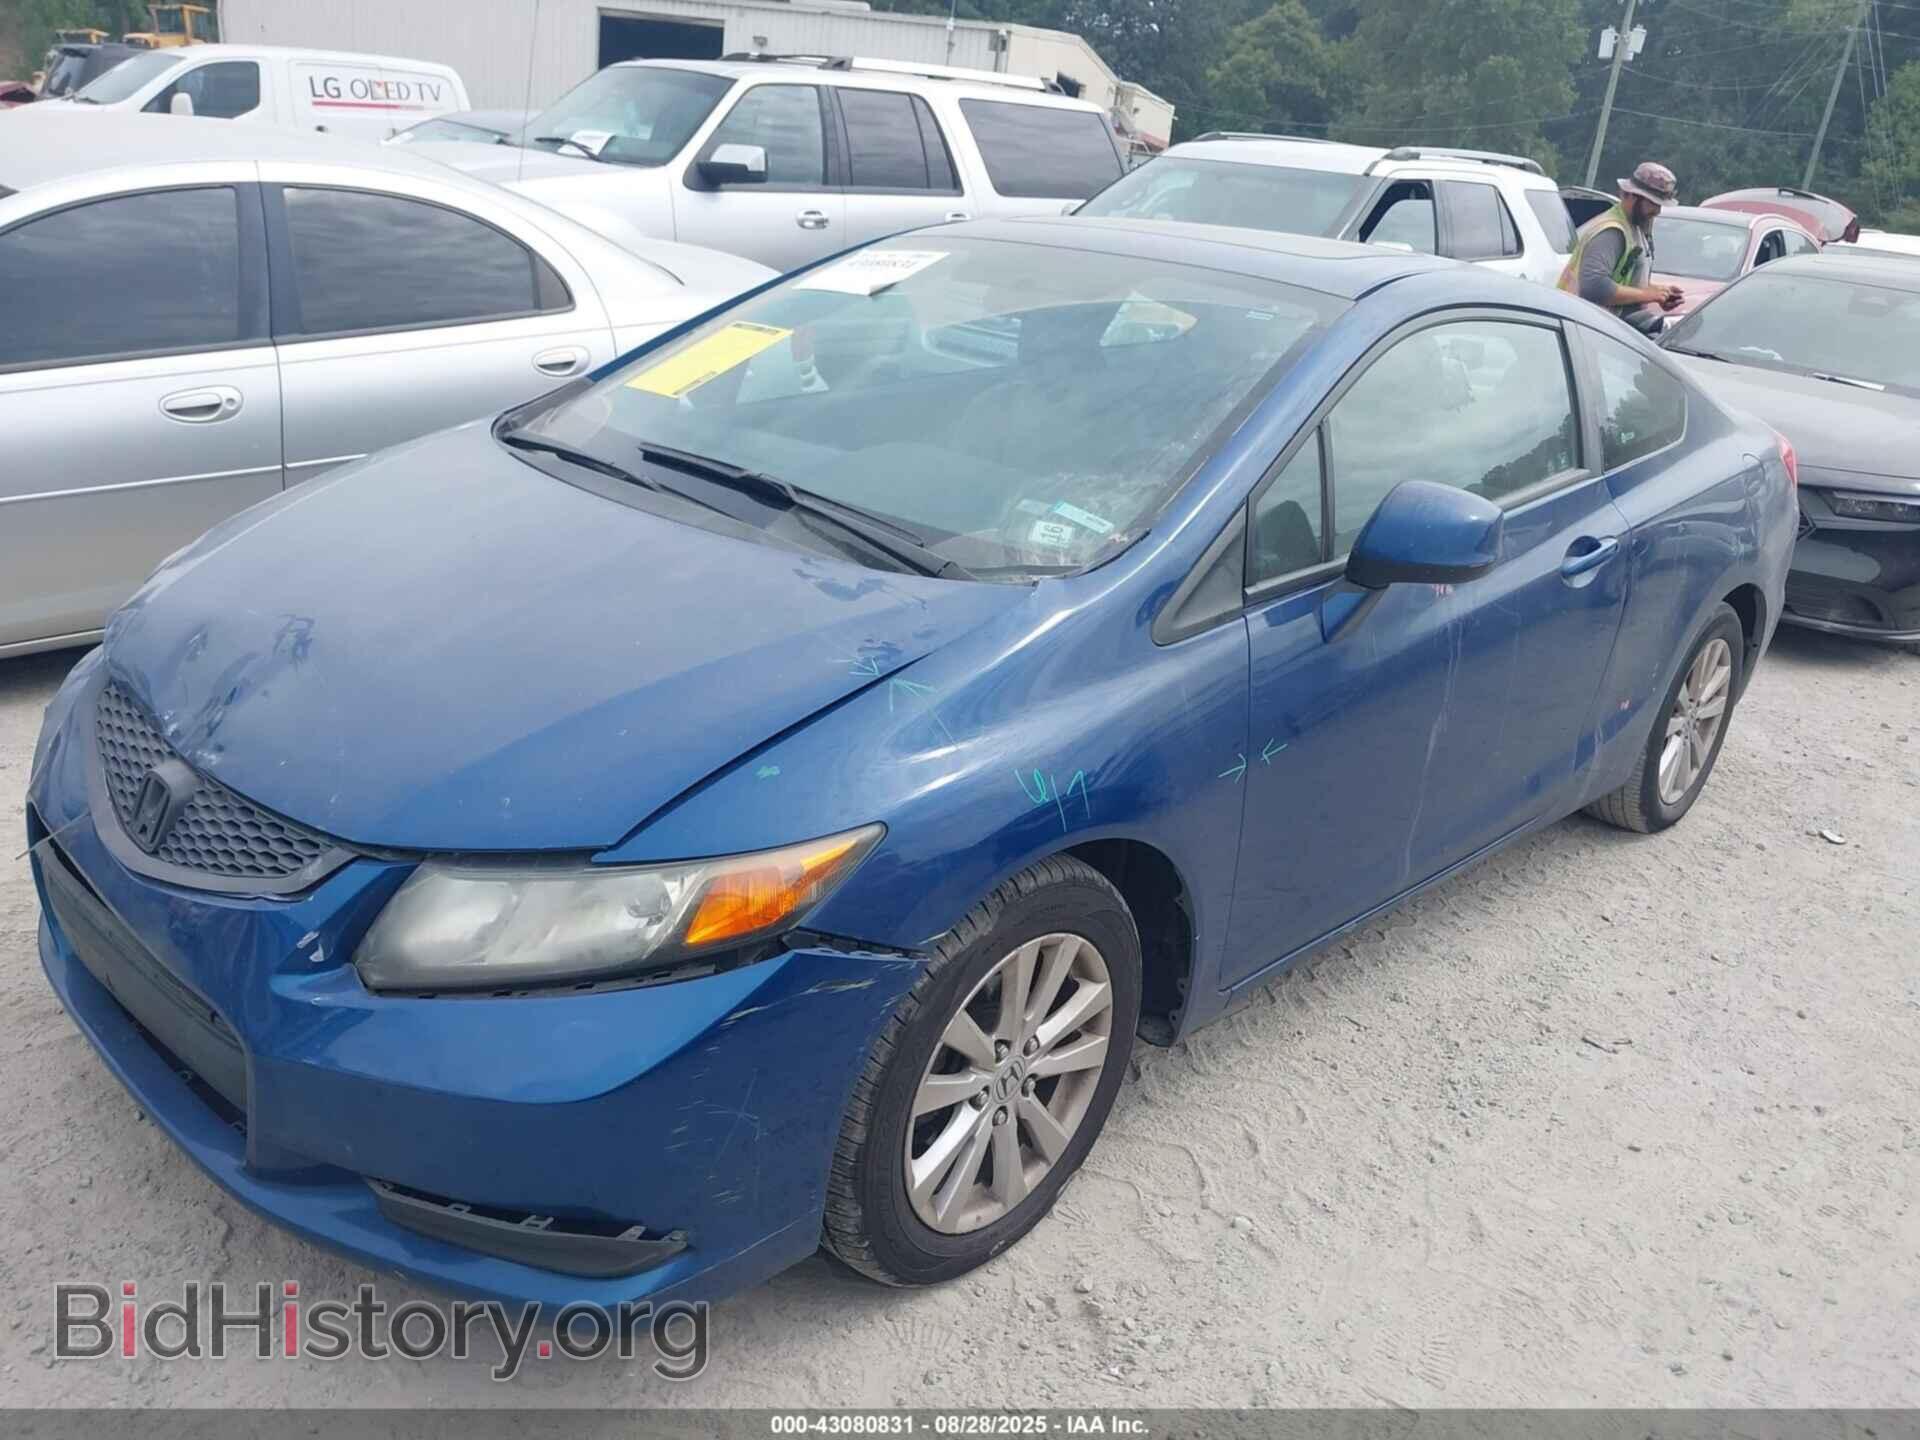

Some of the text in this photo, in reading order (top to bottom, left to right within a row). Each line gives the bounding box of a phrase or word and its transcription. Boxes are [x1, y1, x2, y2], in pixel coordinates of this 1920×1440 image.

[309, 76, 441, 102] LG OLED TV
